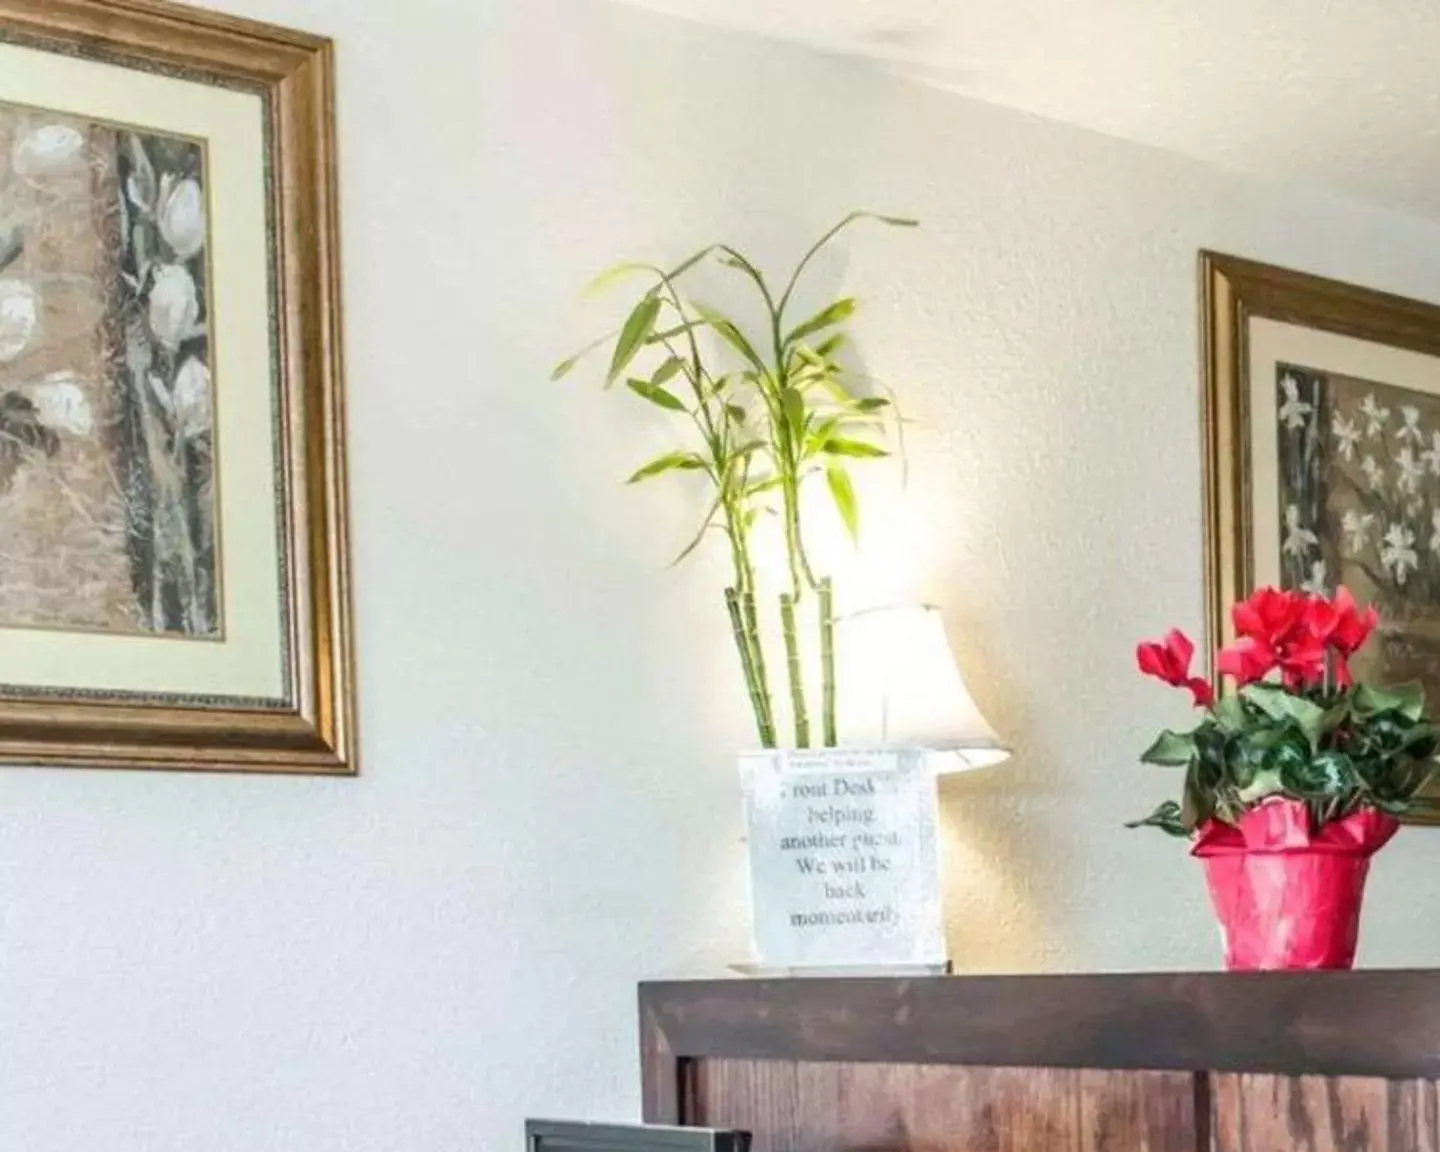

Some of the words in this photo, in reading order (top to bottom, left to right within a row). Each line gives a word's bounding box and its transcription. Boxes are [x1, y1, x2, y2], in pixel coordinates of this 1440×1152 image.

[808, 806, 875, 826] helping
[781, 832, 847, 851] another
[795, 857, 827, 875] We
[832, 856, 867, 874] will
[870, 856, 892, 873] be
[824, 880, 867, 900] back
